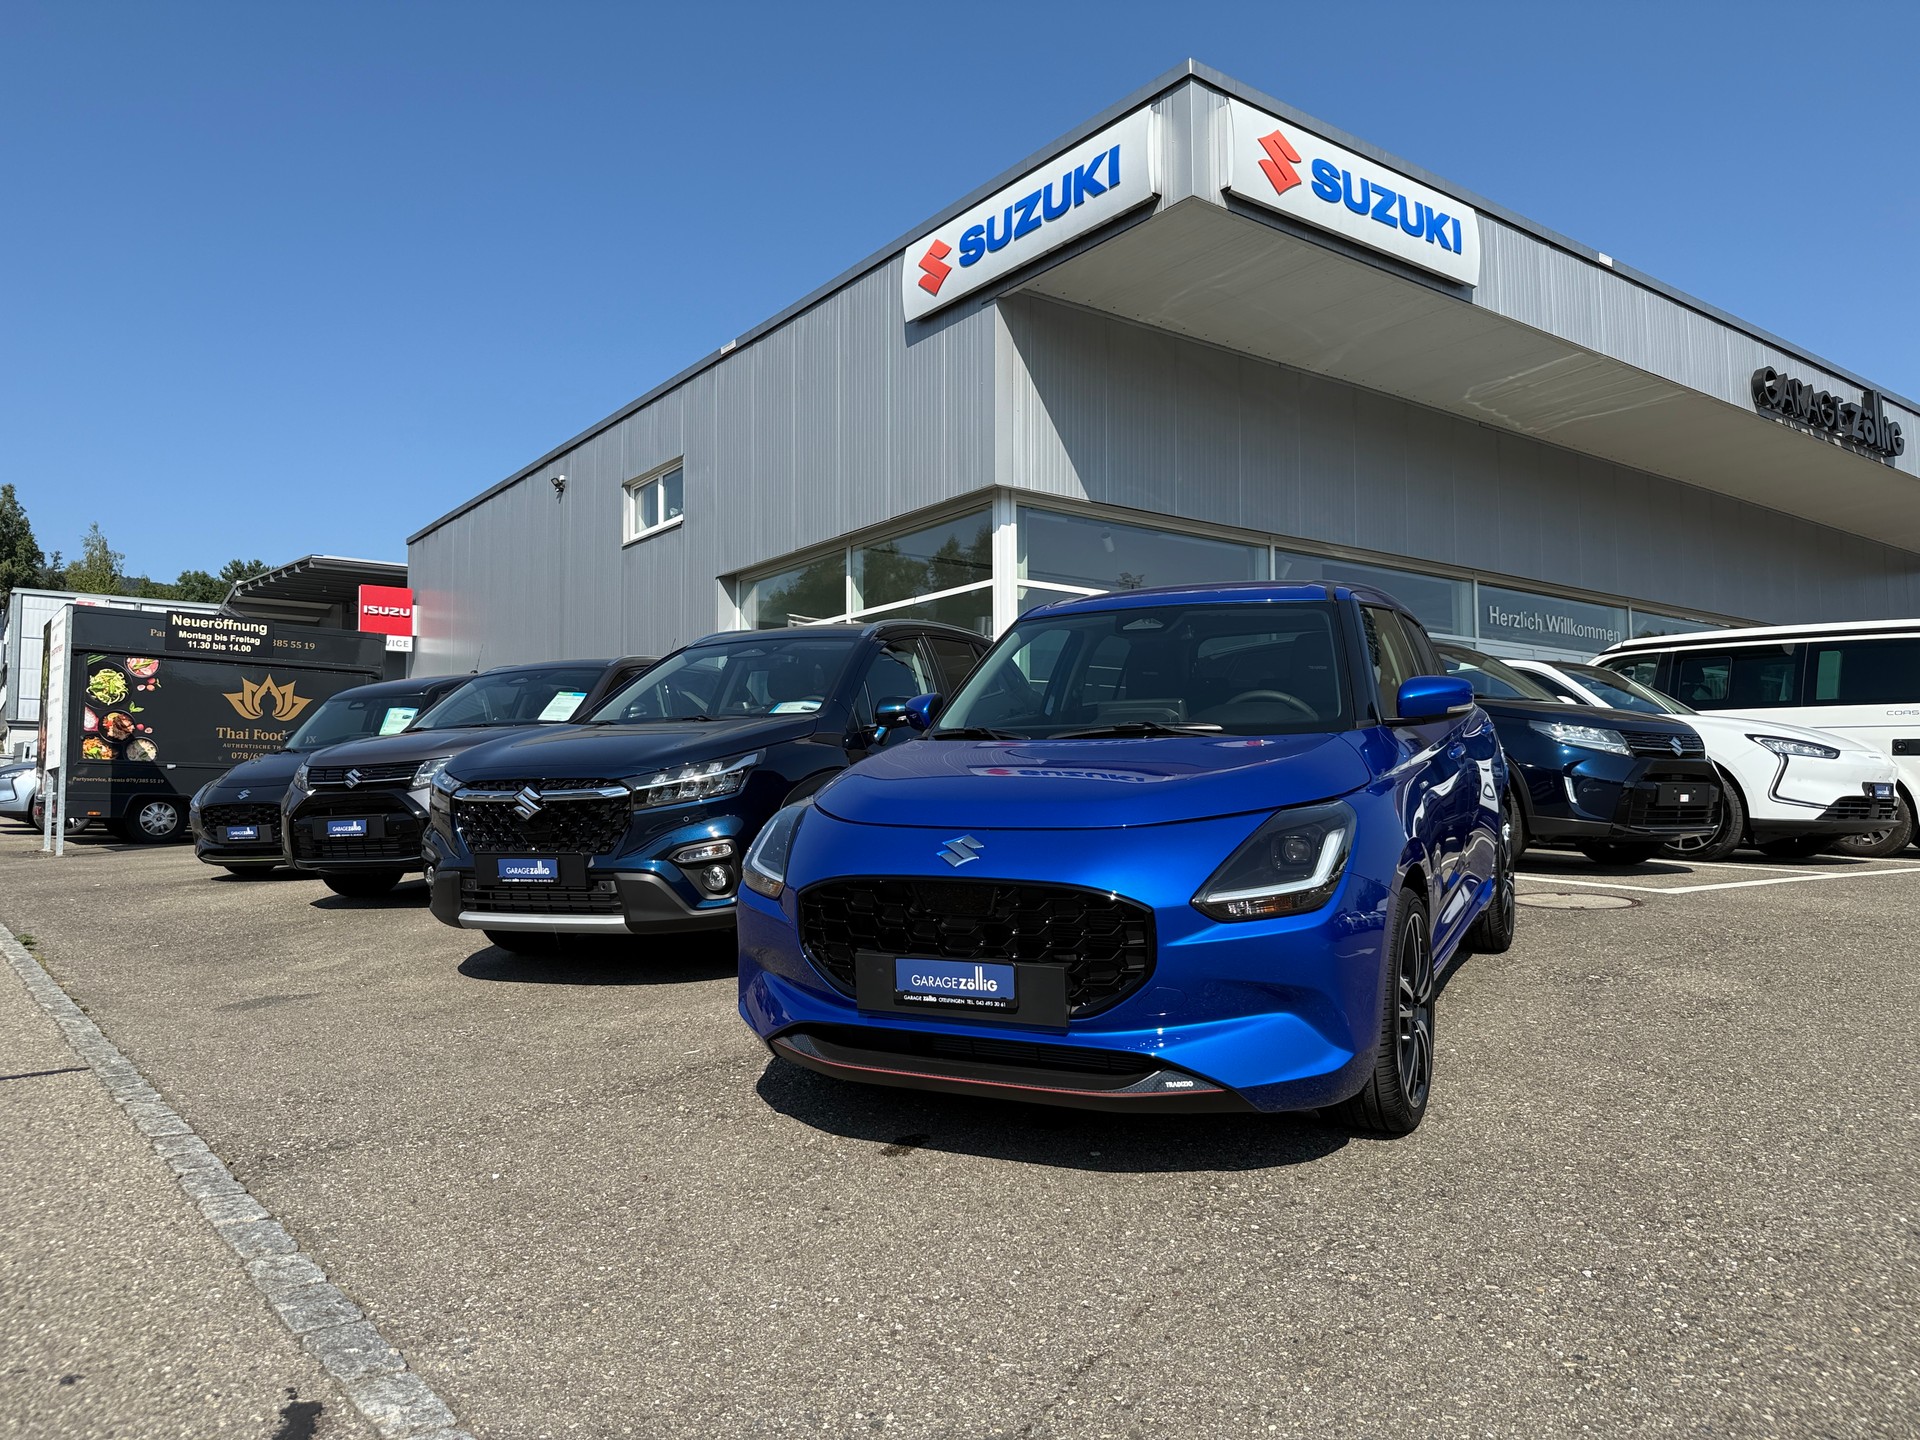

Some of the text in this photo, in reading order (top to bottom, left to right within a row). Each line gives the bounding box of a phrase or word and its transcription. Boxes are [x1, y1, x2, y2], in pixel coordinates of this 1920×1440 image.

[958, 144, 1120, 267] SUZUKI
[1311, 158, 1462, 255] SUZUKI
[363, 605, 411, 617] ISUZU
[172, 614, 268, 635] Neueröffnung
[1489, 605, 1621, 642] Herzlich Willkommen
[178, 630, 261, 646] Montag bis Freitag
[290, 640, 302, 649] 55
[304, 642, 316, 650] 19
[187, 641, 252, 653] 11.30 bis 14.00
[215, 727, 250, 740] Thai
